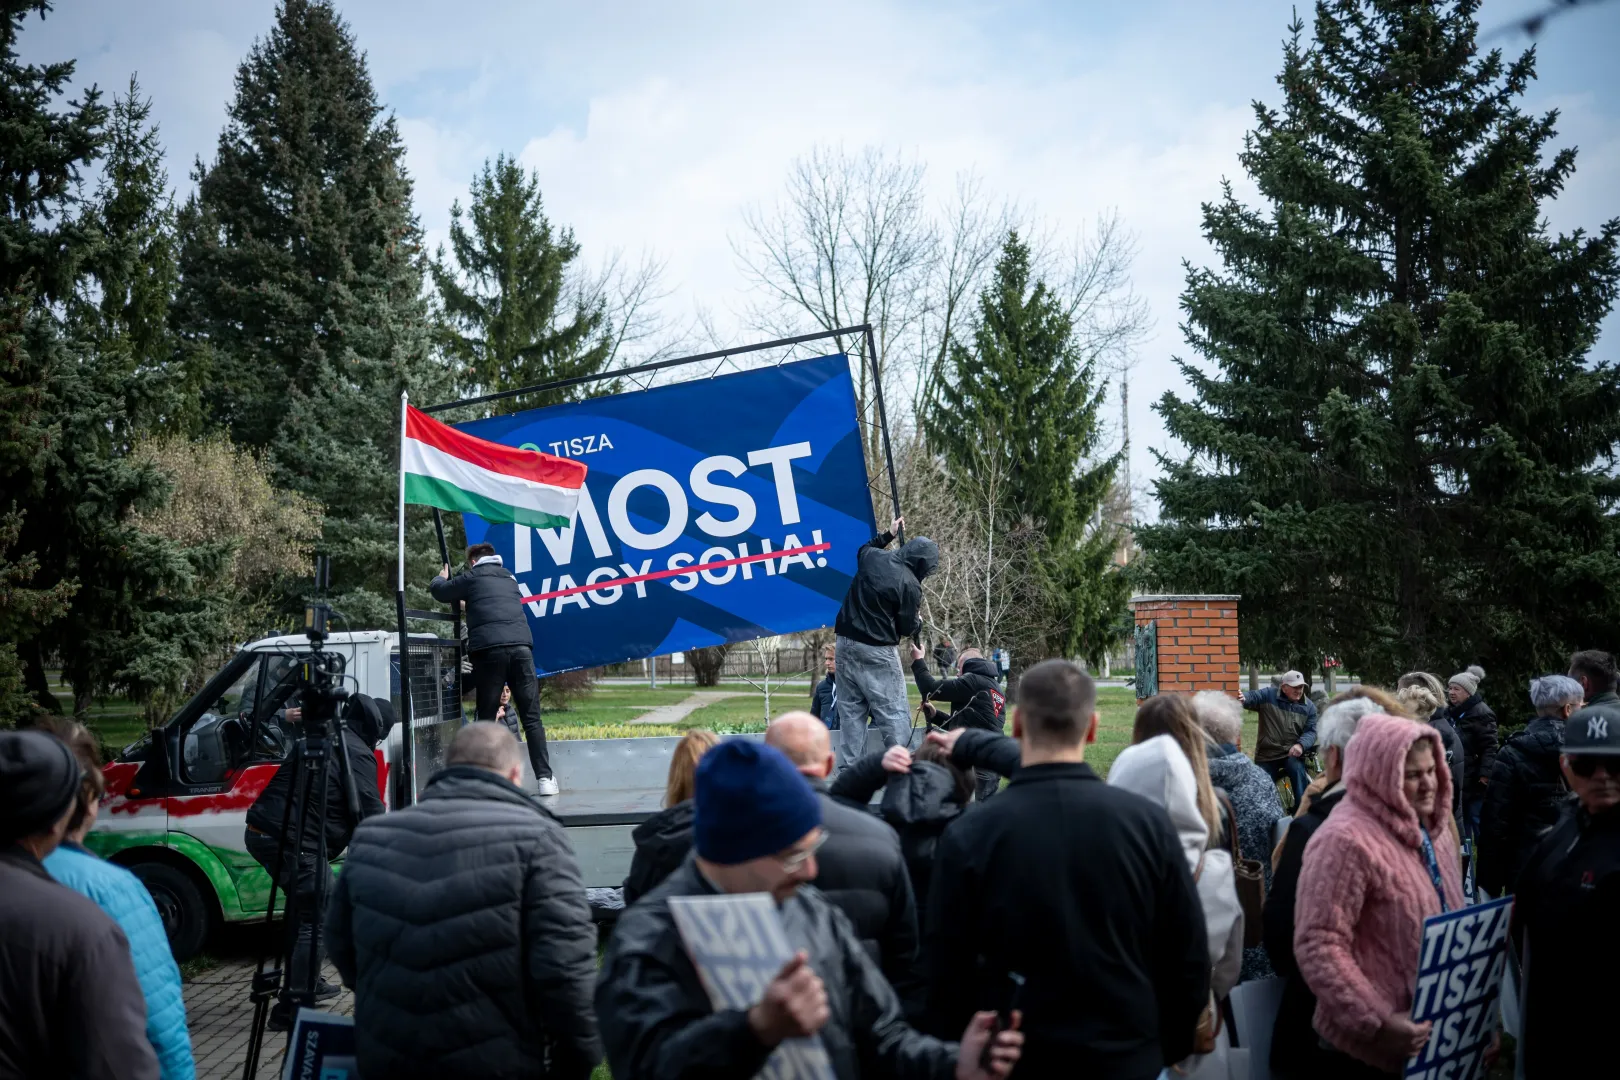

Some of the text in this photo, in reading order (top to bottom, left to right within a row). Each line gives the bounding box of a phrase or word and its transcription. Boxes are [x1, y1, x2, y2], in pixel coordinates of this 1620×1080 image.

[549, 433, 614, 458] TISZA
[513, 441, 812, 574] MOST
[518, 529, 828, 618] VAGY SOHA!
[1421, 902, 1514, 970] TISZA
[1413, 951, 1506, 1019] TISZA
[1407, 1000, 1499, 1071] ISZA
